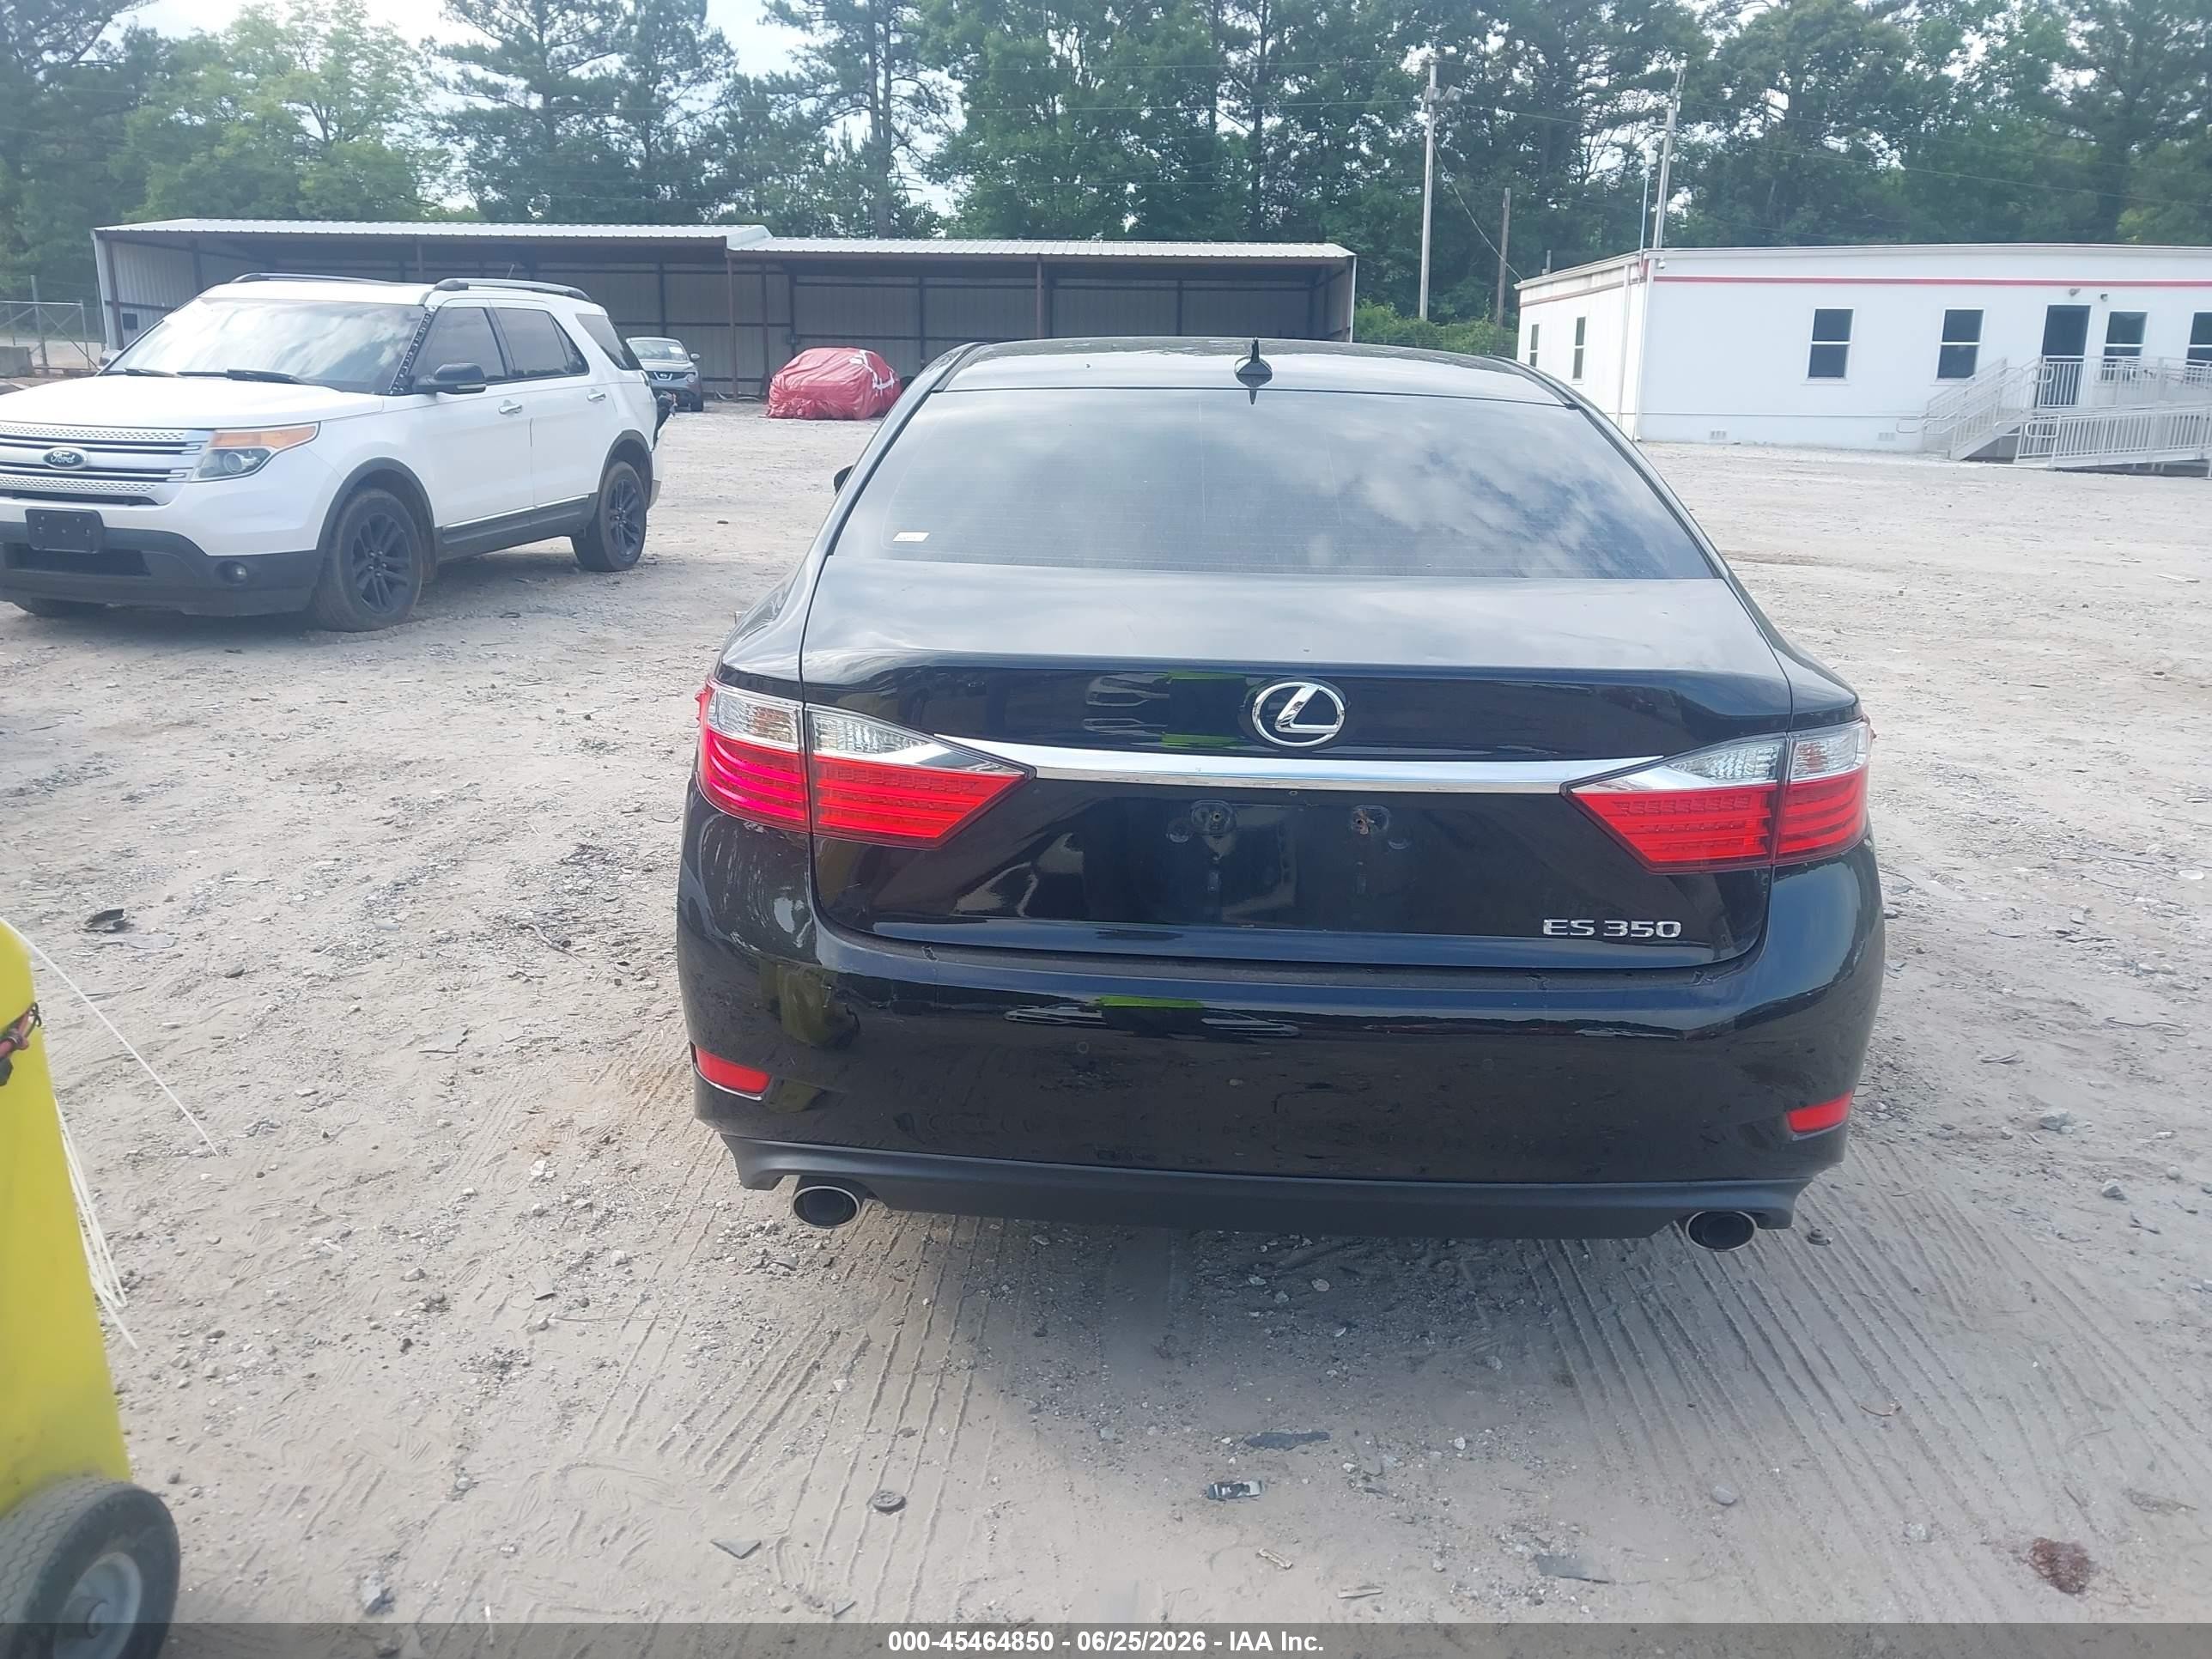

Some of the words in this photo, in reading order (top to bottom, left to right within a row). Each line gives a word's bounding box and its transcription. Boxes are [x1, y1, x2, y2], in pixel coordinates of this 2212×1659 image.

[50, 451, 76, 464] Ford
[1543, 919, 1595, 936] ES
[1603, 920, 1681, 938] 350
